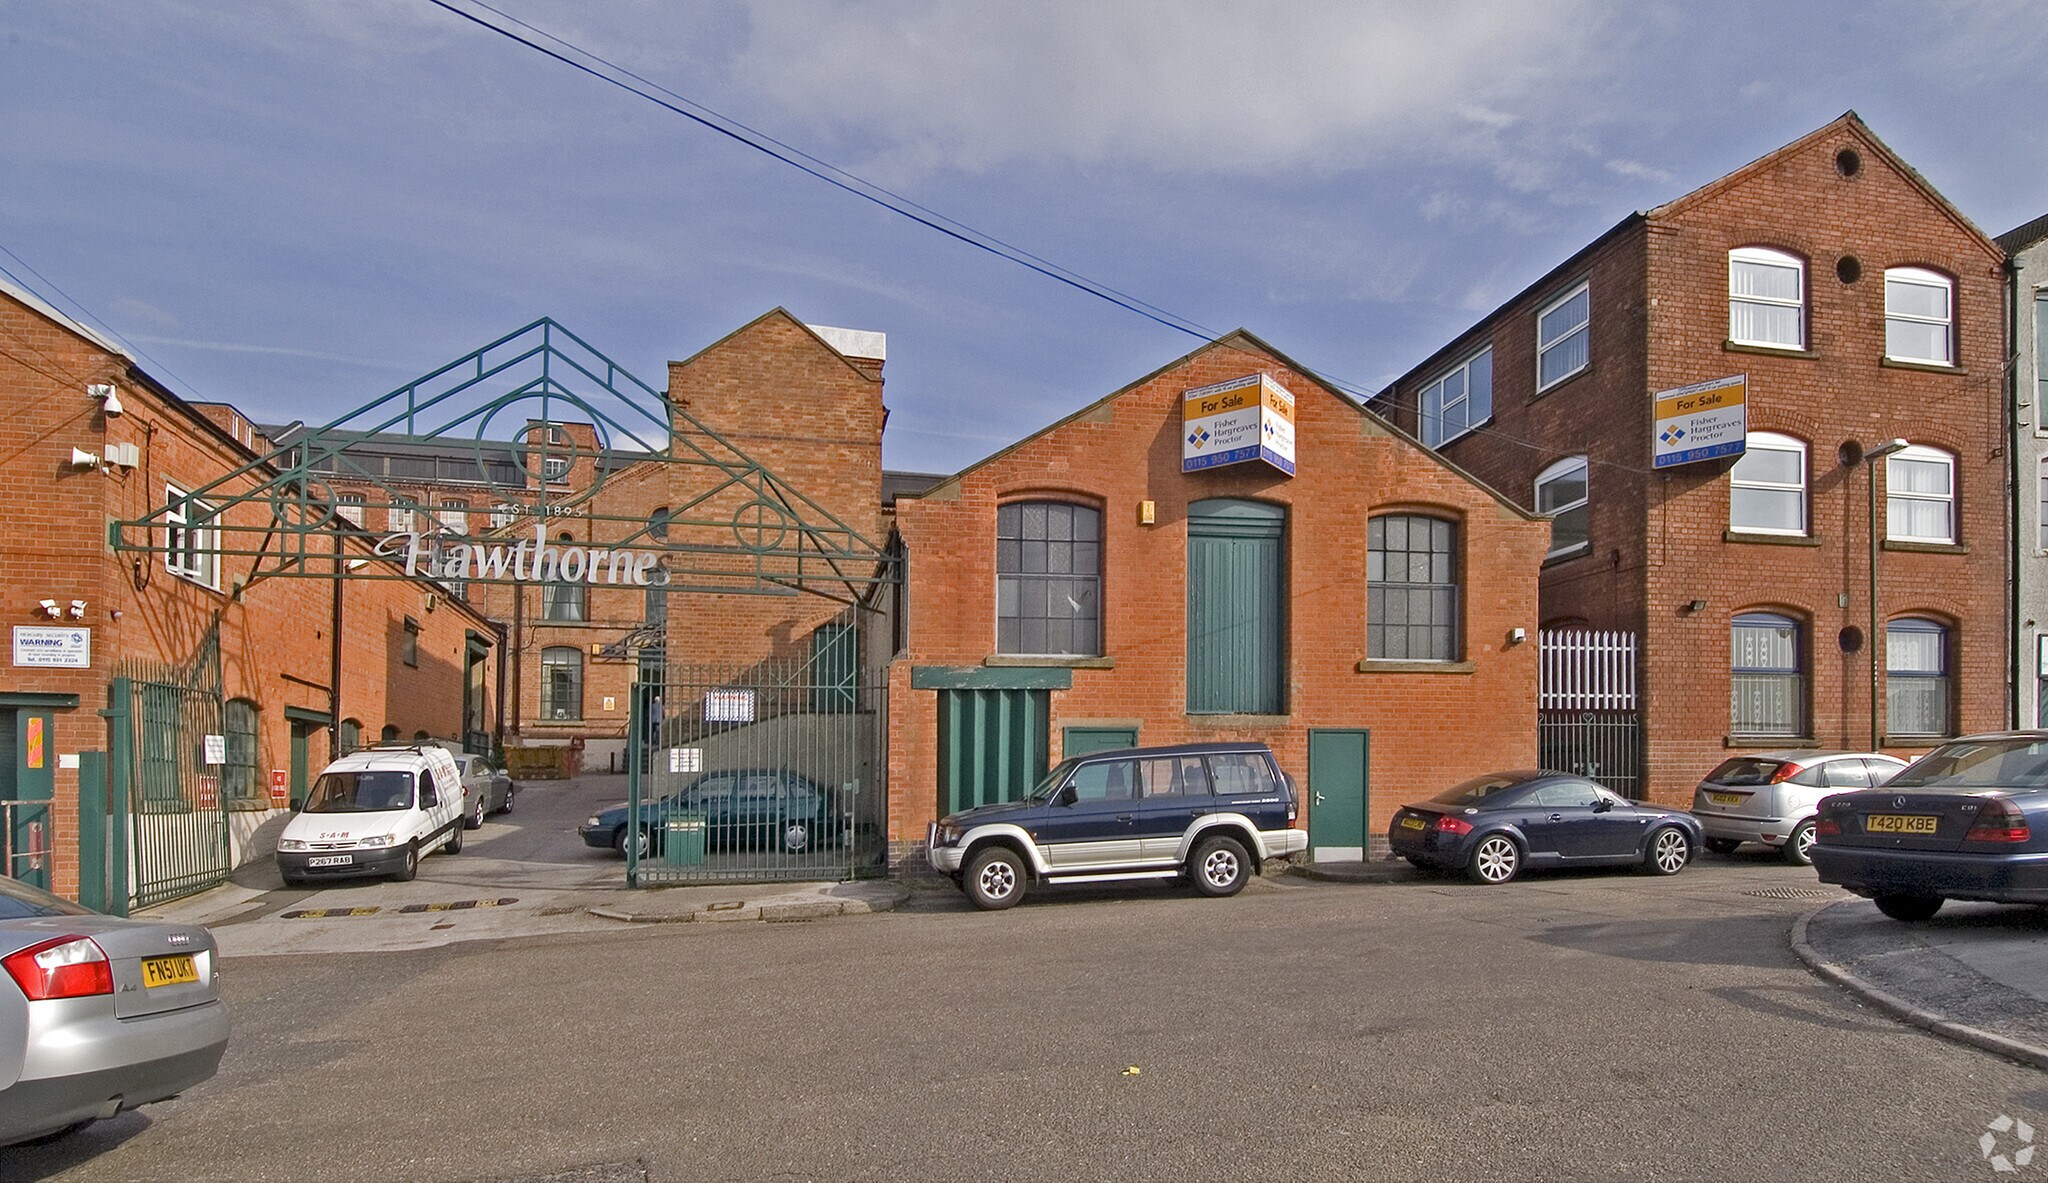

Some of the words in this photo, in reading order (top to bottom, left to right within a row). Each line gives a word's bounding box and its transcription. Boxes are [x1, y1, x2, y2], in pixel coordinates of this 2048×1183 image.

[1201, 401, 1219, 413] For
[1222, 394, 1243, 409] Sale
[1677, 400, 1695, 411] For
[1699, 394, 1722, 406] Sale
[1214, 418, 1238, 429] Fisher
[1690, 416, 1718, 427] Fisher
[1690, 419, 1742, 435] Hargreaves
[1214, 423, 1258, 438] Hargreaves
[1690, 431, 1724, 443] Proctor
[1214, 435, 1243, 446] Proctor
[1187, 457, 1208, 469] 0115
[1211, 453, 1230, 464] 950
[1234, 446, 1258, 460] 7577
[1658, 454, 1683, 465] 0115
[1687, 449, 1709, 460] 950
[1715, 442, 1742, 455] 7577
[545, 505, 583, 517] 1895
[374, 521, 673, 587] Hawthornes
[20, 639, 63, 647] WARNING
[1869, 816, 1903, 831] T420
[1906, 816, 1935, 831] KBE
[333, 856, 351, 864] RAB
[147, 960, 176, 982] FN51
[174, 958, 194, 978] UKT
